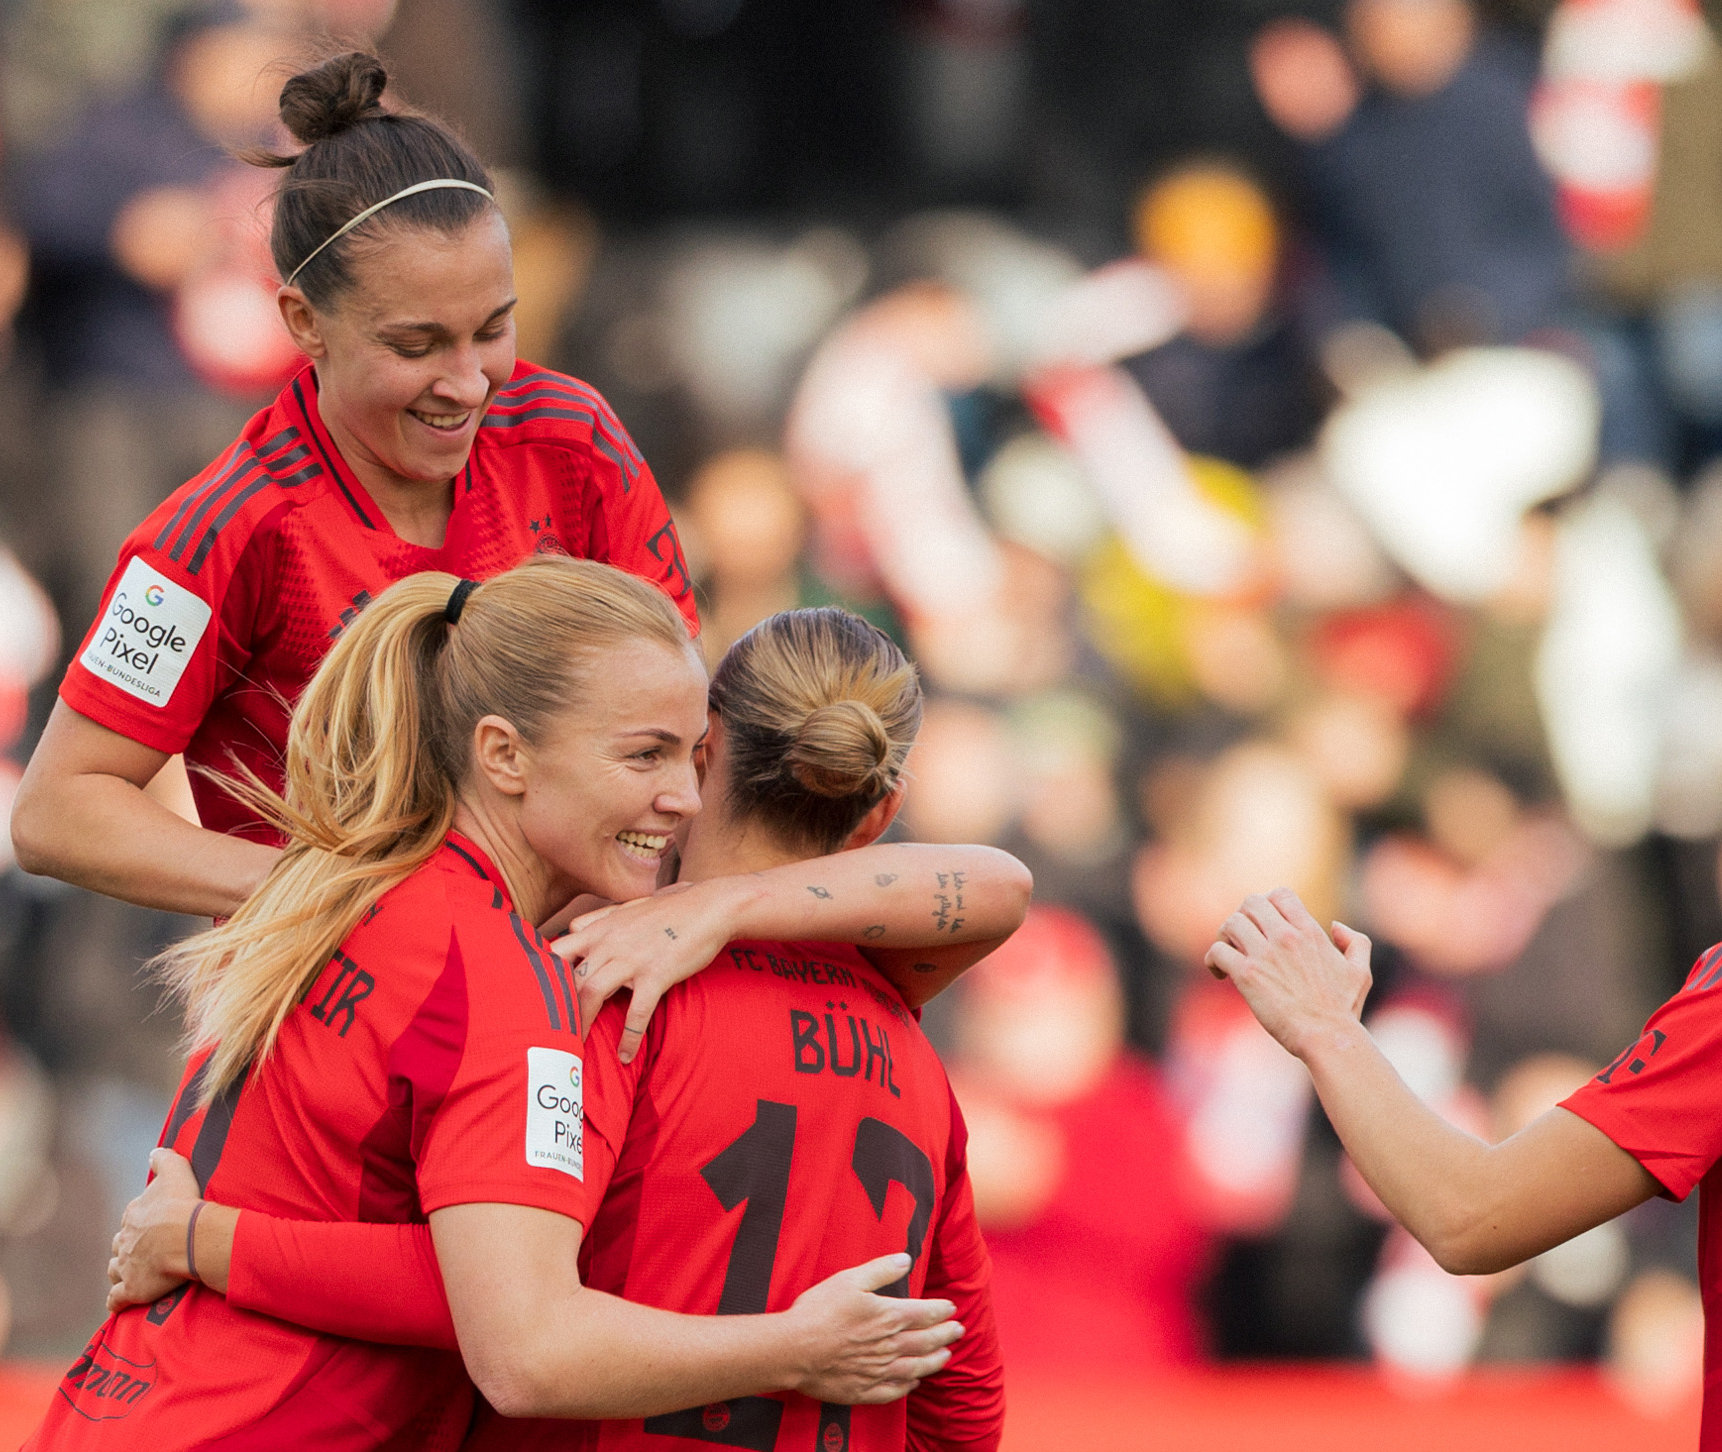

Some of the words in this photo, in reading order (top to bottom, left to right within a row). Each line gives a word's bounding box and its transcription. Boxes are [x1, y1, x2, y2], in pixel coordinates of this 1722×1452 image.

[112, 592, 186, 653] Google
[99, 627, 159, 675] Pixel
[731, 948, 762, 972] FC
[765, 952, 857, 989] BAYERN
[790, 1000, 901, 1100] BÜHL
